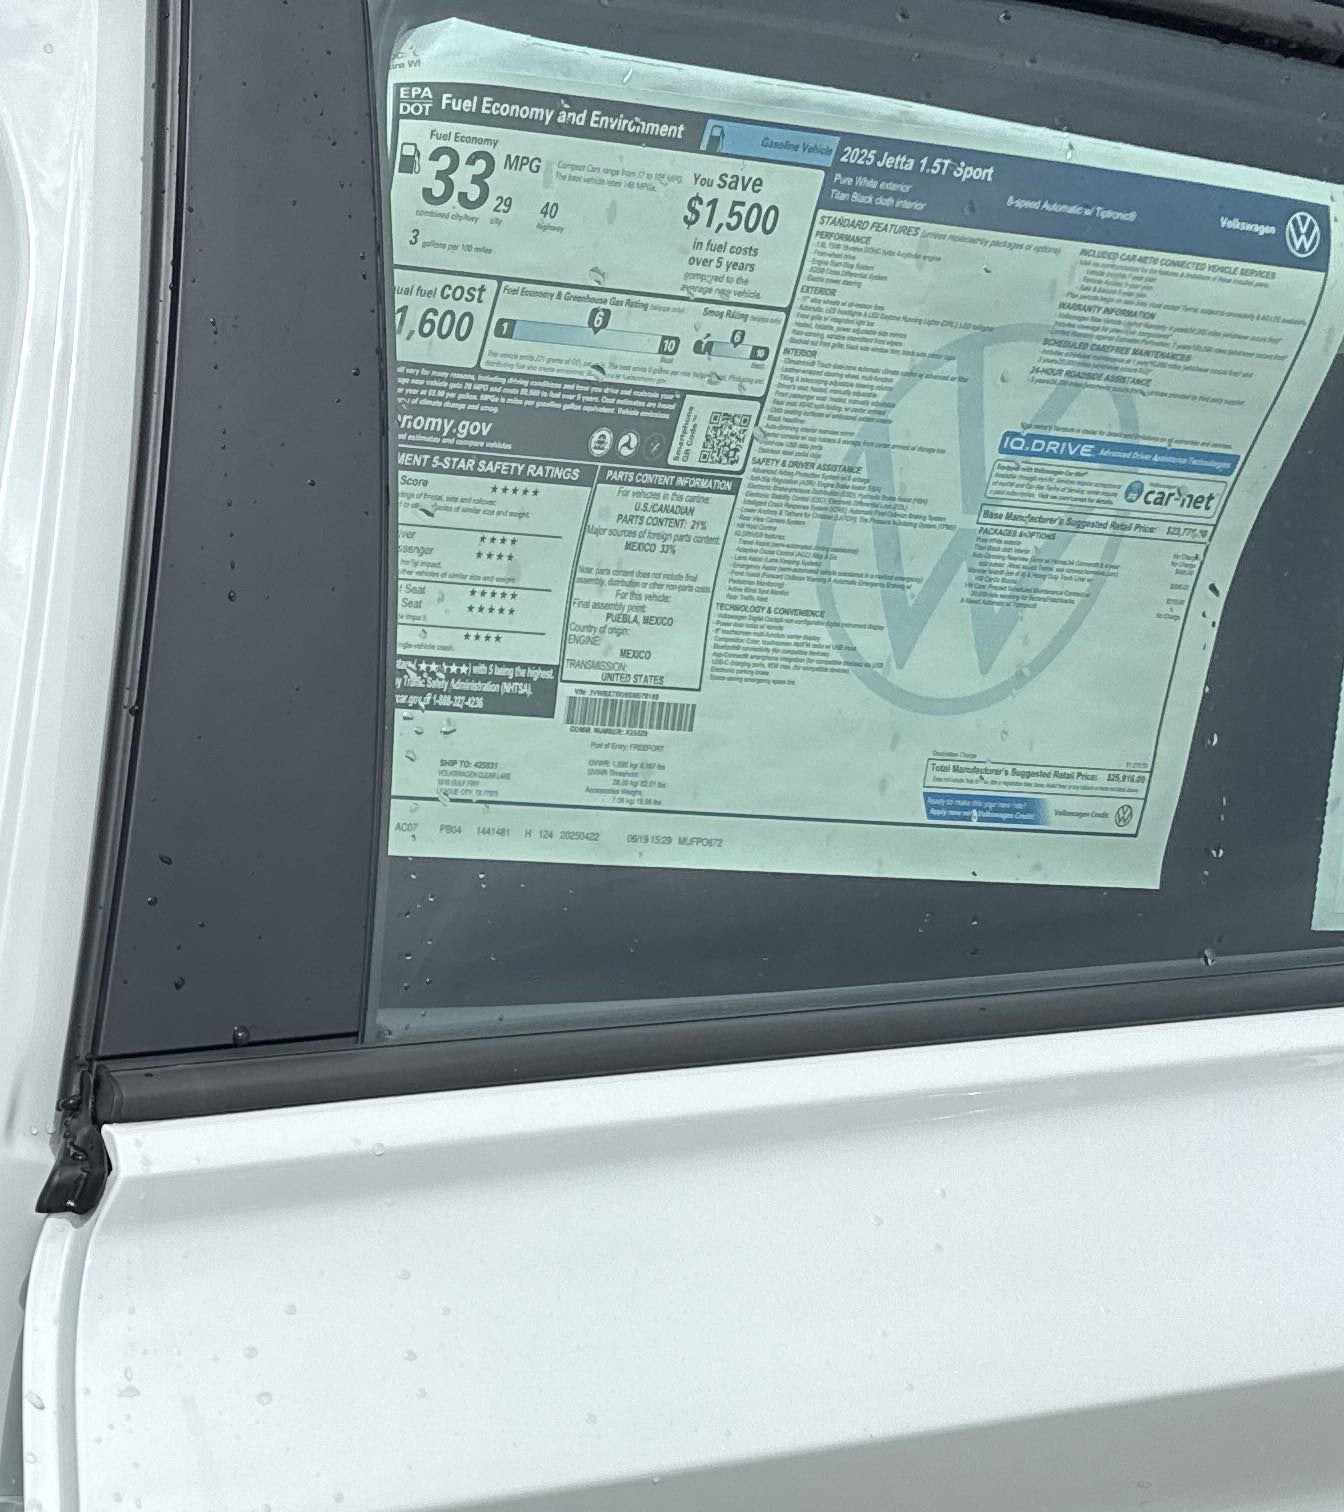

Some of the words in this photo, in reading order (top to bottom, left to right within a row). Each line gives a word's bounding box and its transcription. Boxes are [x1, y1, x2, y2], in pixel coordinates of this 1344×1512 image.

[400, 87, 433, 99] EPA
[400, 103, 432, 116] DOT
[441, 94, 477, 112] Fuel
[481, 97, 554, 125] Economy
[557, 109, 587, 126] and
[589, 110, 685, 140] Environment
[430, 130, 451, 141] Fuel
[455, 133, 499, 149] Economy
[762, 137, 799, 152] Gasoline
[802, 143, 833, 156] Vehicle
[504, 154, 542, 173] MPG
[840, 147, 875, 165] 2025
[877, 151, 915, 171] Jetta
[920, 156, 949, 175] 1.5T
[953, 162, 994, 182] Sport
[422, 146, 495, 210] 33
[694, 173, 713, 187] You
[717, 173, 763, 193] save
[834, 173, 853, 185] Pure
[855, 176, 878, 189] White
[880, 179, 912, 192] exterior
[493, 195, 513, 214] 29
[830, 189, 849, 201] Titan
[851, 192, 873, 205] Black
[895, 197, 926, 210] interior
[540, 202, 559, 219] 40
[683, 193, 780, 235] $1,500
[819, 215, 869, 230] STANDARD
[870, 221, 921, 236] FEATURES
[1220, 216, 1275, 236] Volkswagen
[409, 229, 419, 245] 3
[693, 238, 703, 250] in
[705, 239, 727, 252] fuel
[730, 244, 758, 257] costs
[689, 256, 713, 268] over
[716, 256, 723, 268] 5
[726, 260, 755, 273] years
[394, 284, 413, 296] ual
[416, 285, 437, 298] fuel
[440, 284, 486, 303] cost
[504, 285, 519, 295] Fuel
[520, 287, 554, 300] Economy
[594, 311, 604, 327] 6
[663, 339, 675, 351] 10
[734, 332, 741, 342] 6
[398, 414, 492, 437] nomy.gov
[1004, 436, 1095, 457] IQ.DRIVE
[432, 456, 475, 471] 5-STAR
[478, 460, 524, 475] SAFETY
[527, 464, 581, 480] RATINGS
[400, 475, 428, 487] Score
[606, 470, 634, 482] PARTS
[636, 472, 674, 485] CONTENT
[676, 475, 732, 490] INFORMATION
[616, 514, 644, 525] PARTS
[601, 672, 631, 683] UNITED
[633, 674, 664, 685] STATES
